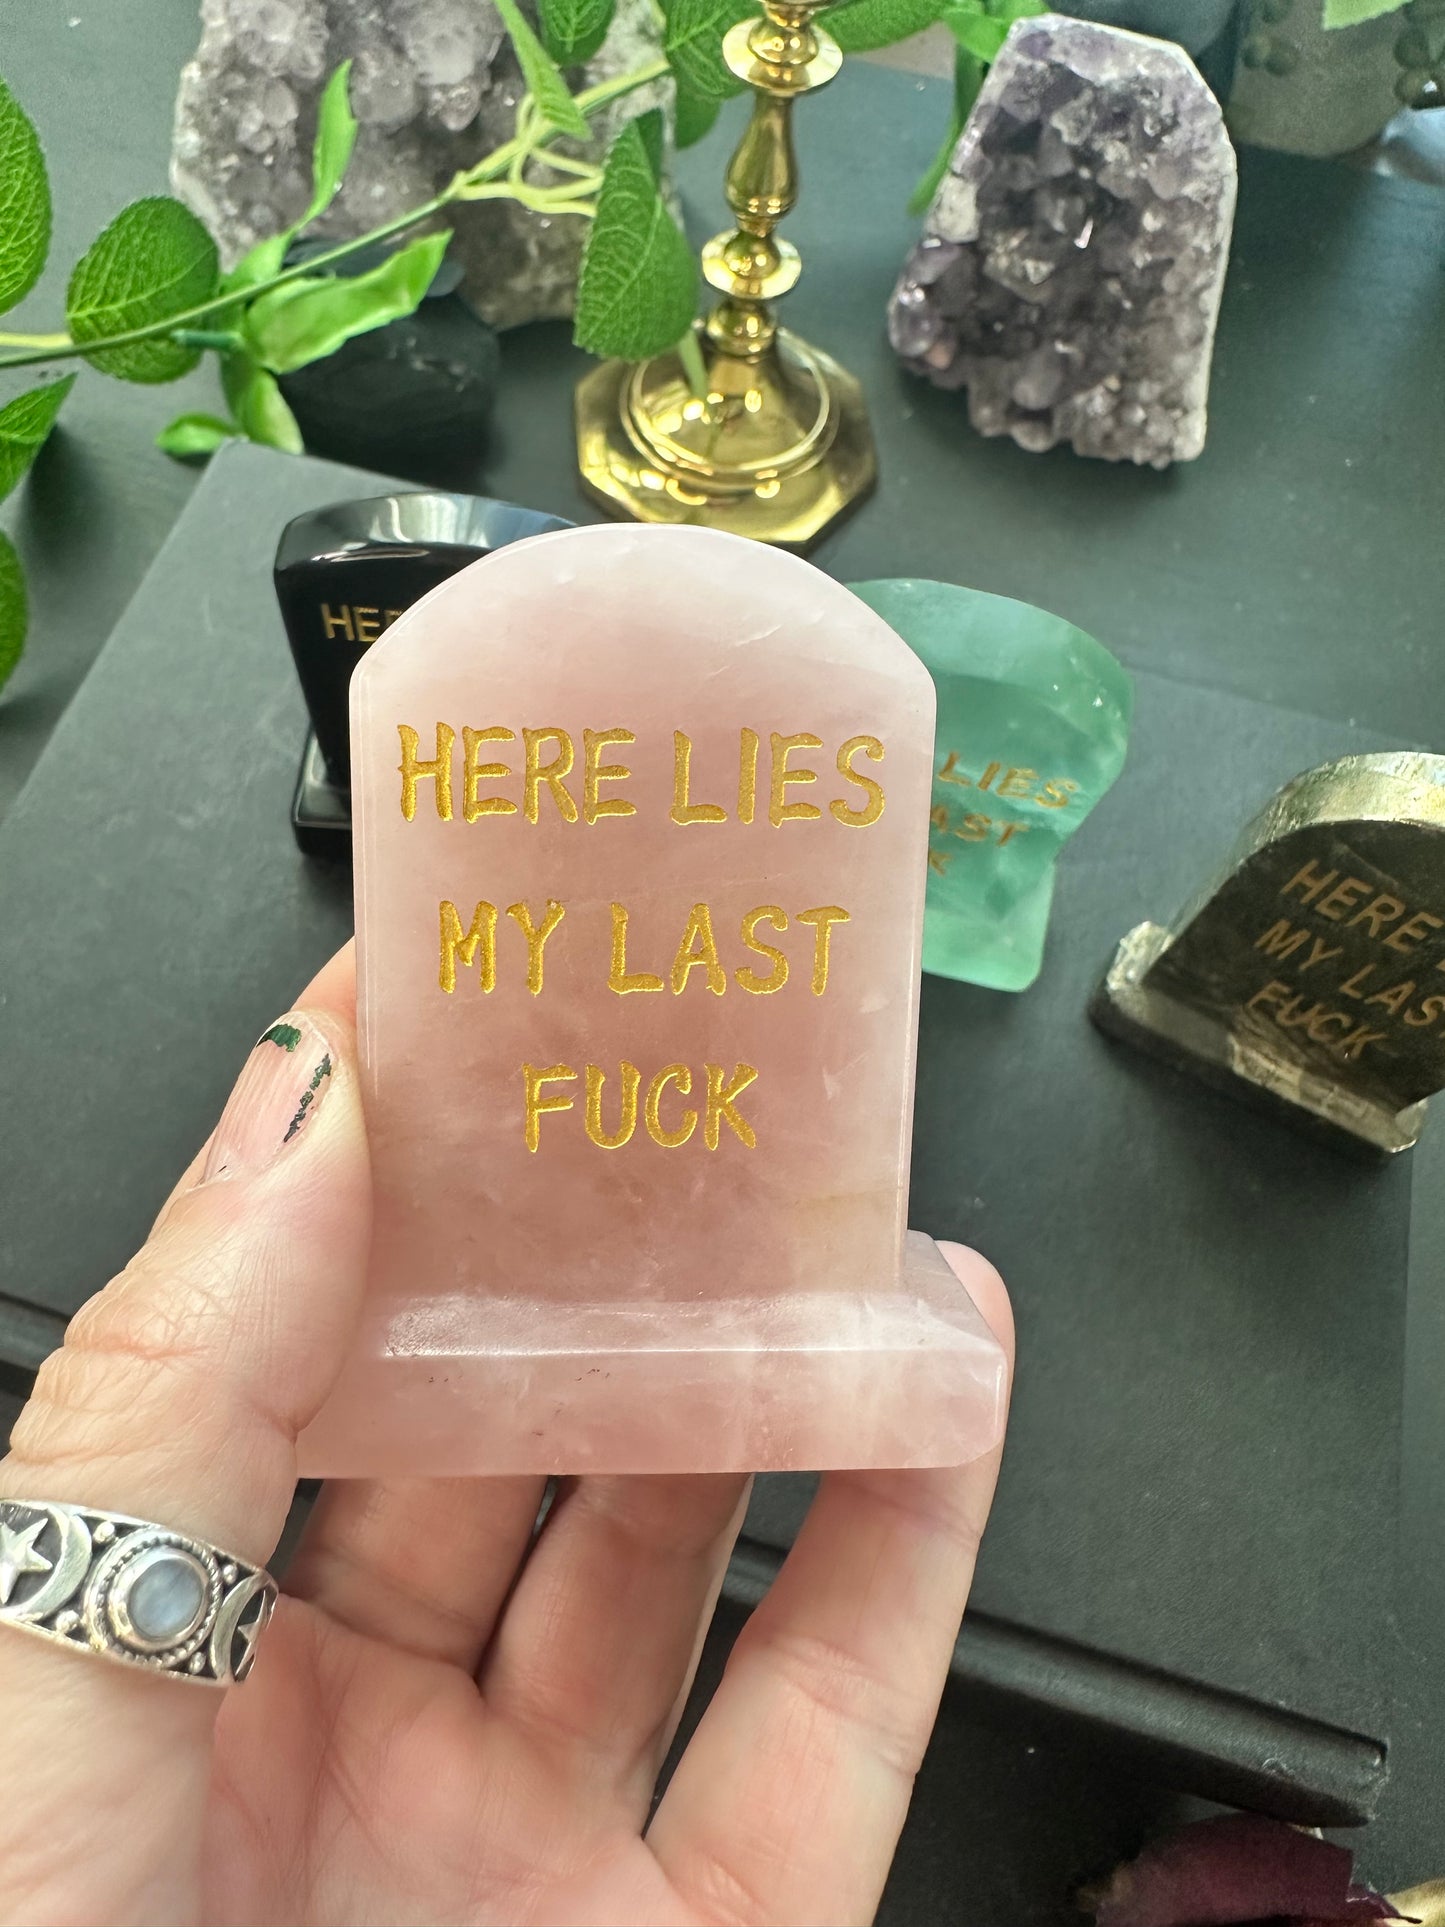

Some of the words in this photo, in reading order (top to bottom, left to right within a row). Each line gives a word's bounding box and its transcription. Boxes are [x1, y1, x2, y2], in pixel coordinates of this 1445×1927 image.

[398, 721, 637, 825] HERE
[670, 727, 886, 828] LIES
[938, 751, 1079, 809] LIES
[930, 804, 1030, 847] AST
[439, 900, 566, 995] MY
[607, 902, 852, 996] LAST
[1280, 859, 1444, 954] HERE
[1246, 980, 1388, 1060] FUCK
[1254, 919, 1345, 971] MY
[1339, 964, 1445, 1039] LAS
[522, 1060, 759, 1153] FUCK
